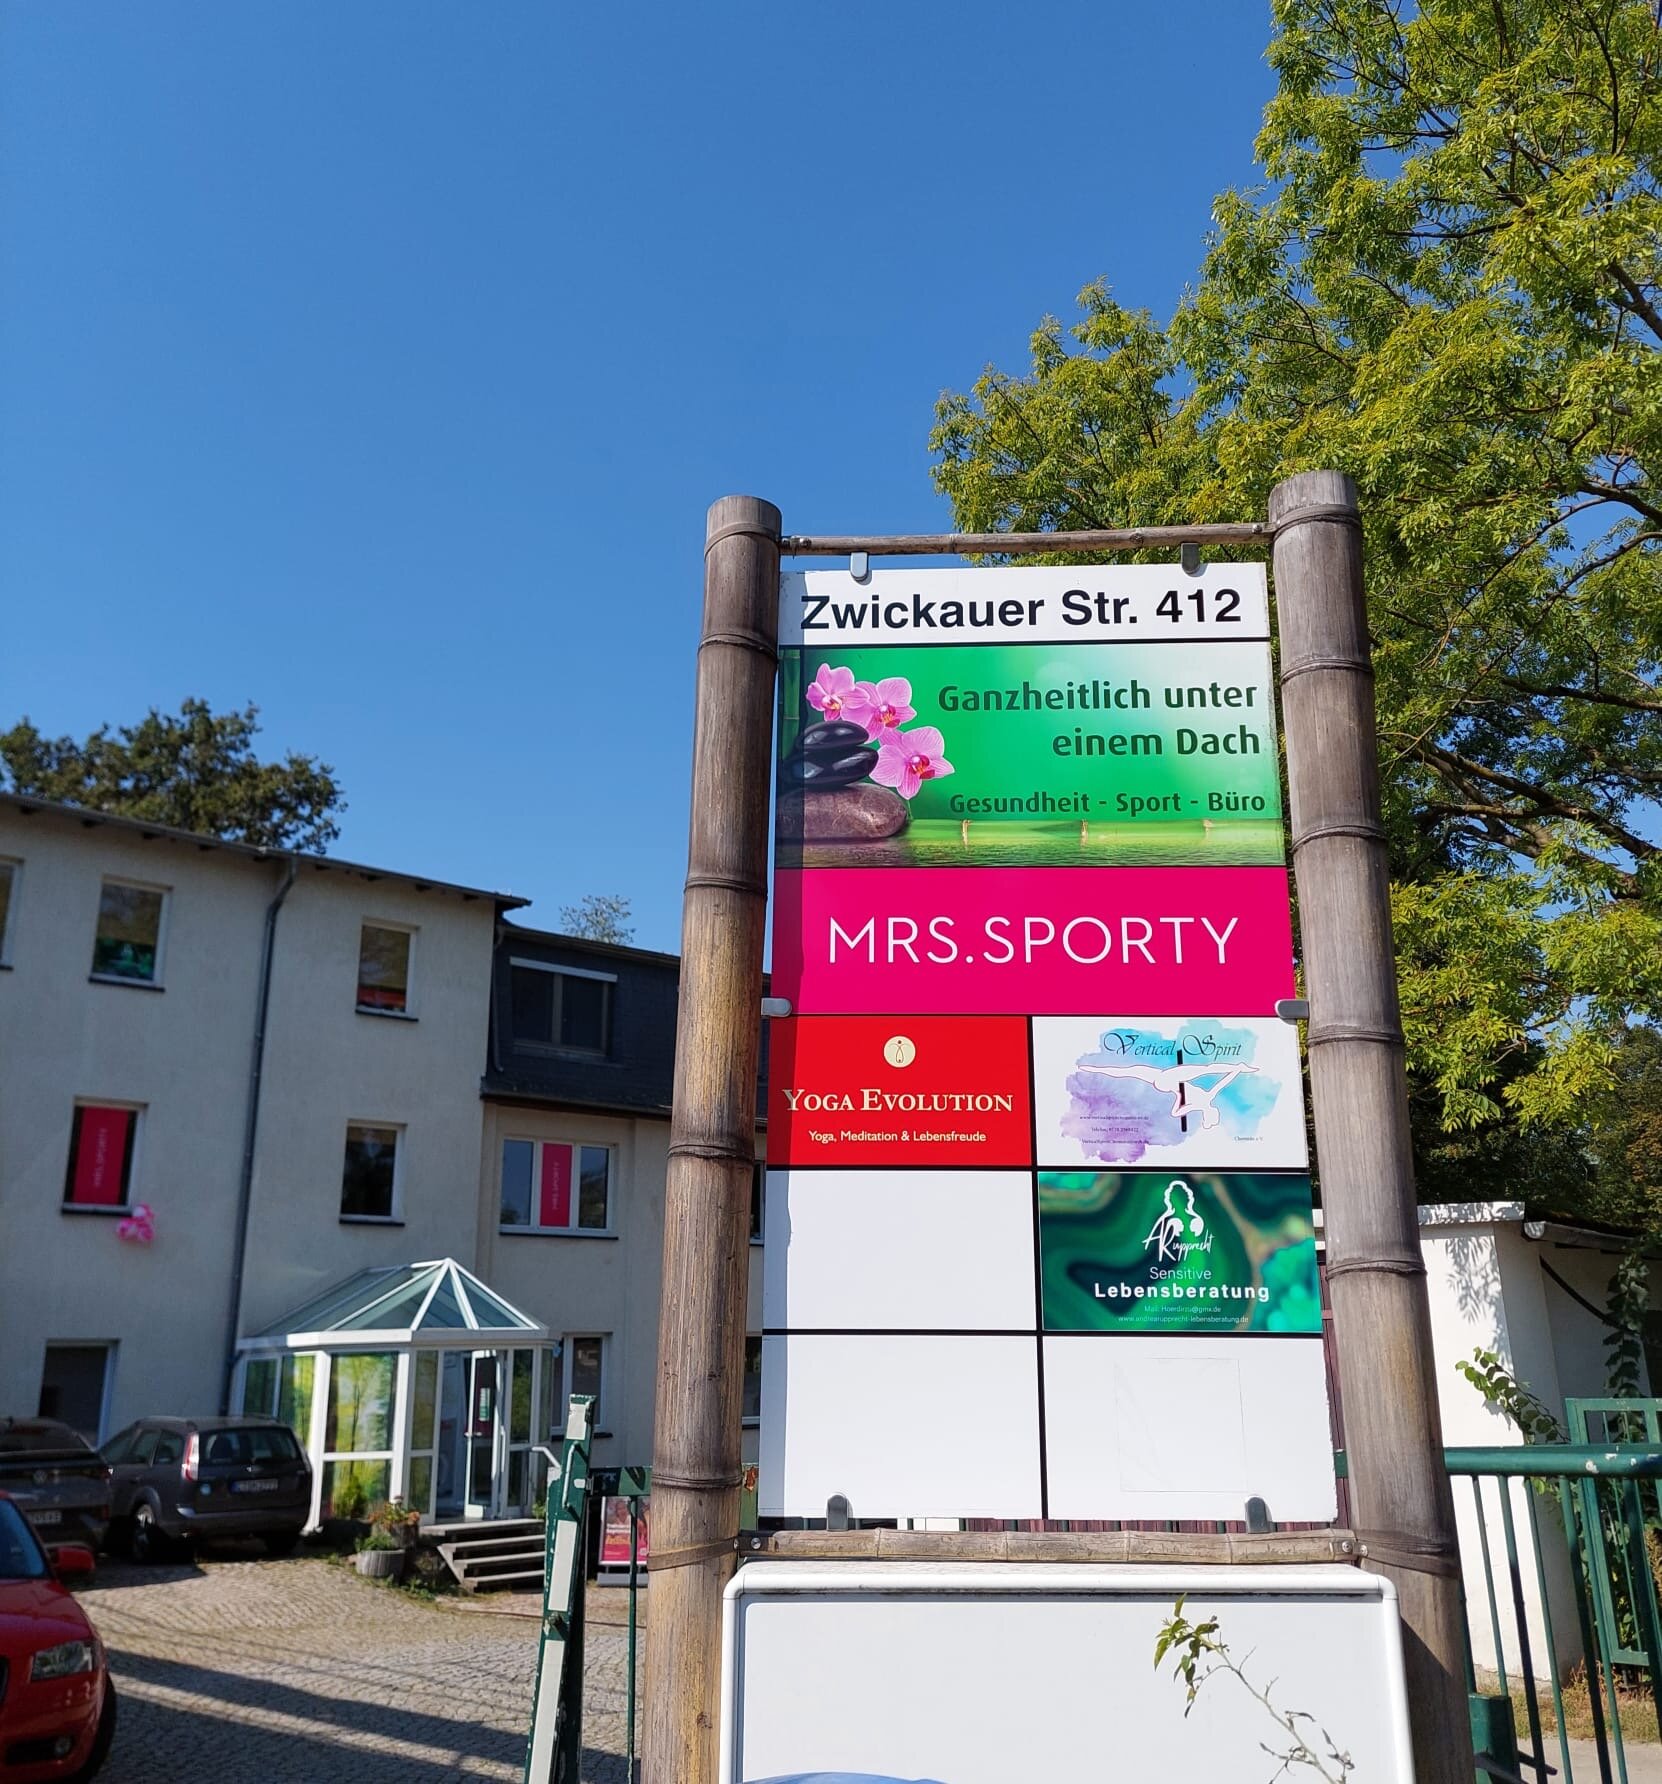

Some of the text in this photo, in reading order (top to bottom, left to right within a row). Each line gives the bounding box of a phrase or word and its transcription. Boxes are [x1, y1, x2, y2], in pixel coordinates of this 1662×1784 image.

[801, 588, 1242, 629] Zwickauer Str. 412
[939, 680, 1257, 712] Ganzheitlich unter
[1052, 725, 1260, 756] einem Dach
[950, 792, 1090, 814] Gesundheit
[1116, 792, 1181, 816] Sport
[1208, 791, 1266, 812] Büro
[828, 916, 1239, 964] MRS.SPORTY
[1103, 1032, 1242, 1061] Vertical Spirit
[782, 1088, 1013, 1113] YOGA EVOLUTION
[809, 1130, 987, 1143] Yoga, Meditation & Lebensfreude
[1150, 1266, 1212, 1280] Sensitive
[1094, 1282, 1270, 1302] Lebensberatung
